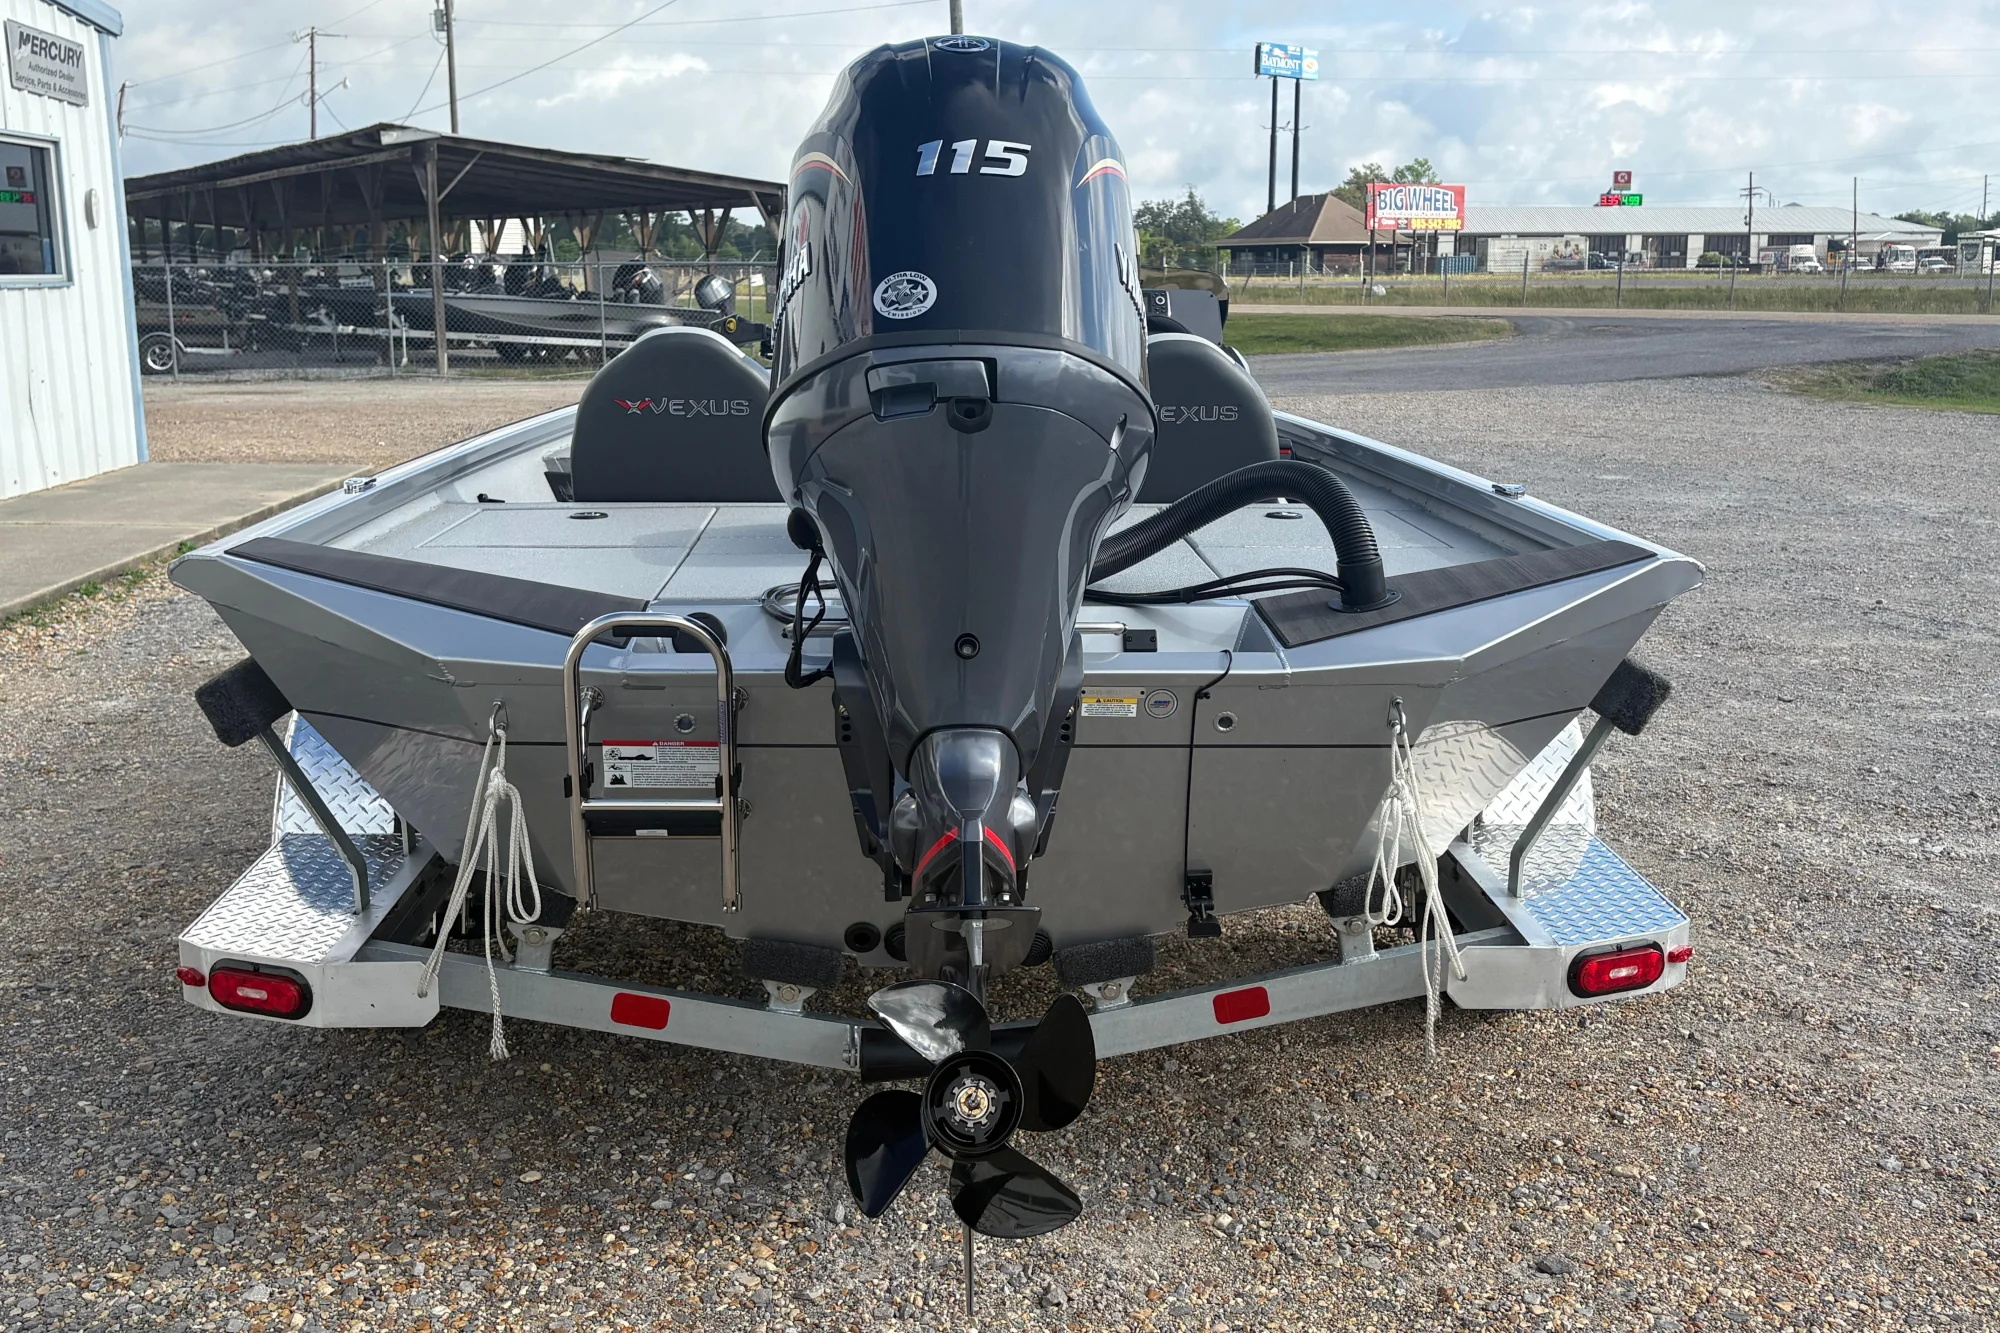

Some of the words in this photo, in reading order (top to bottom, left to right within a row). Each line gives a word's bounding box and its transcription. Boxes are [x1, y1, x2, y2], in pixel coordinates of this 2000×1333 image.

[18, 30, 82, 69] MERCURY
[28, 61, 57, 78] Authorized
[58, 70, 75, 82] Dealer
[1261, 53, 1301, 70] BAYMONT
[15, 72, 37, 88] Service,
[37, 78, 52, 91] Parts
[53, 83, 57, 92] &
[57, 84, 87, 100] Accessories
[916, 139, 1032, 177] 115
[1379, 186, 1404, 211] BIG
[1407, 187, 1457, 212] WHEEL
[887, 308, 923, 317] EMISSION
[645, 398, 750, 418] VEXUS
